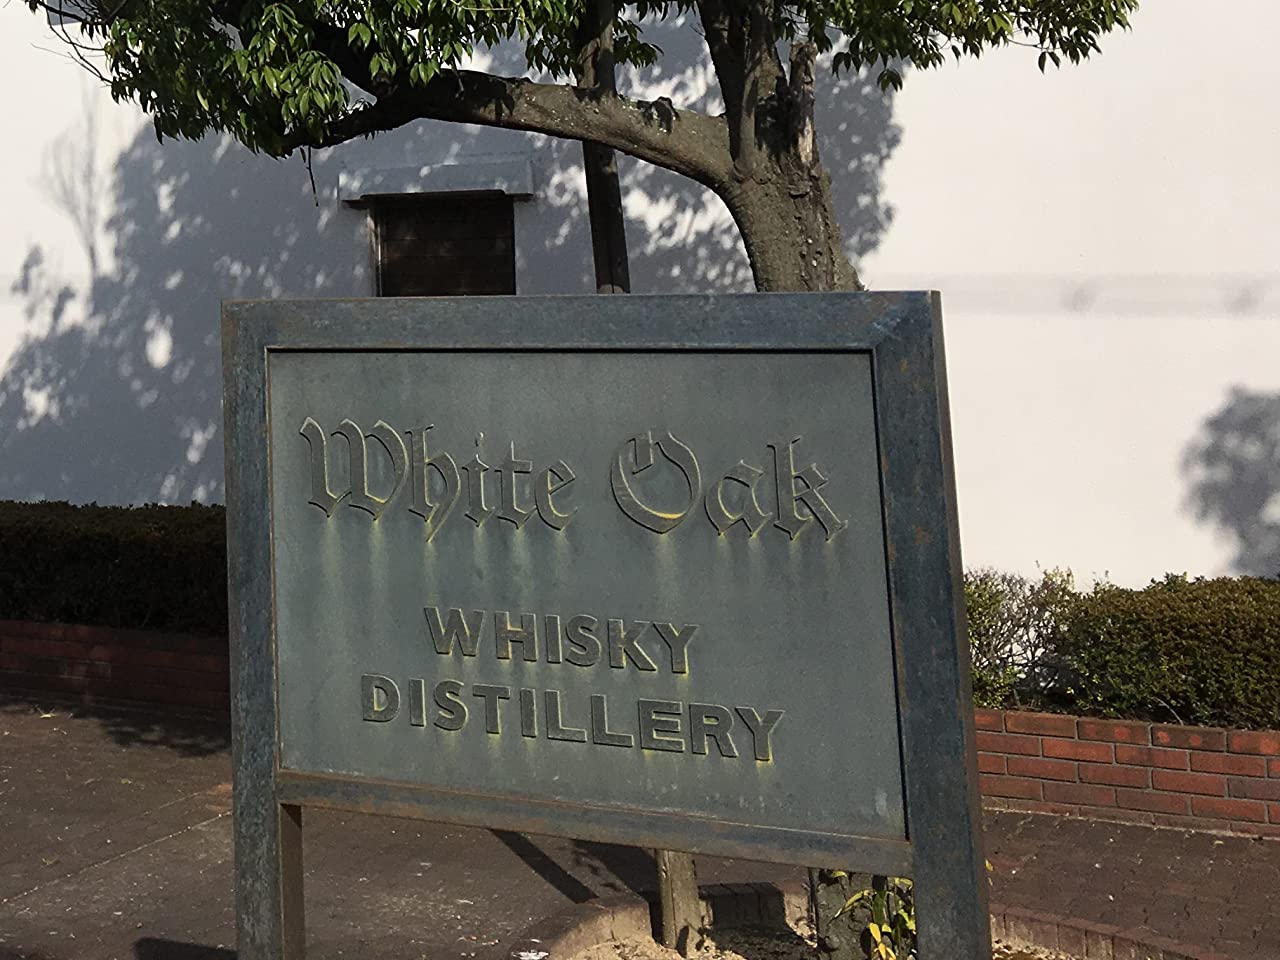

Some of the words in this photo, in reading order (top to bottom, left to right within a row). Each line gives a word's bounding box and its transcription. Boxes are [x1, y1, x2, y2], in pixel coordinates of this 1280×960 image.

[299, 415, 578, 543] White
[610, 429, 849, 541] Oak
[423, 606, 700, 676] WHISKY
[361, 673, 786, 763] DISTILLERY
